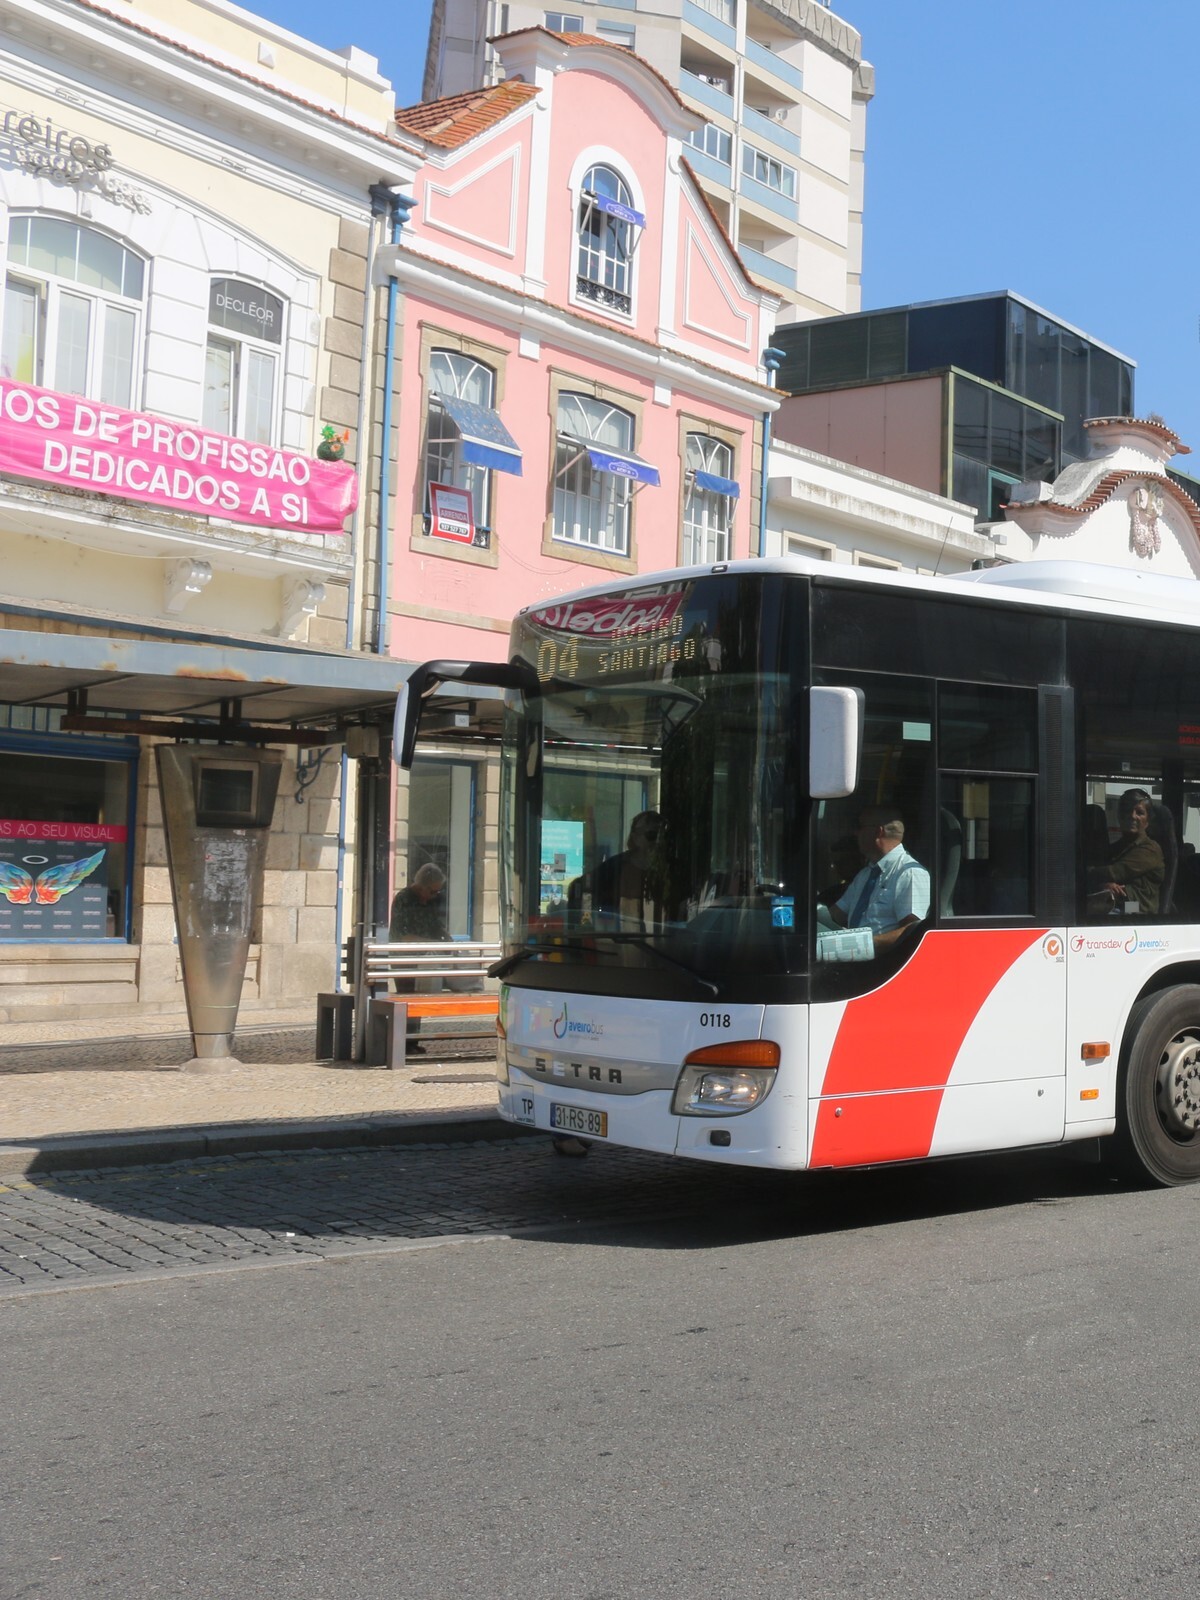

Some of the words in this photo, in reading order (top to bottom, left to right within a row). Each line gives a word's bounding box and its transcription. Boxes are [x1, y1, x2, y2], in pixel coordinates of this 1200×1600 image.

[0, 385, 60, 429] OS
[73, 404, 120, 443] DE
[43, 440, 240, 510] DEDICADOS
[250, 487, 271, 518] A
[281, 493, 308, 525] SI
[537, 636, 579, 683] 04
[598, 638, 695, 674] SANTIAGO
[17, 823, 37, 836] AO
[42, 823, 68, 838] SEU
[73, 825, 114, 840] VISUAL
[1086, 938, 1123, 950] transdev
[700, 1012, 731, 1029] 0118
[535, 1057, 622, 1084] SETRA
[521, 1098, 533, 1115] TP
